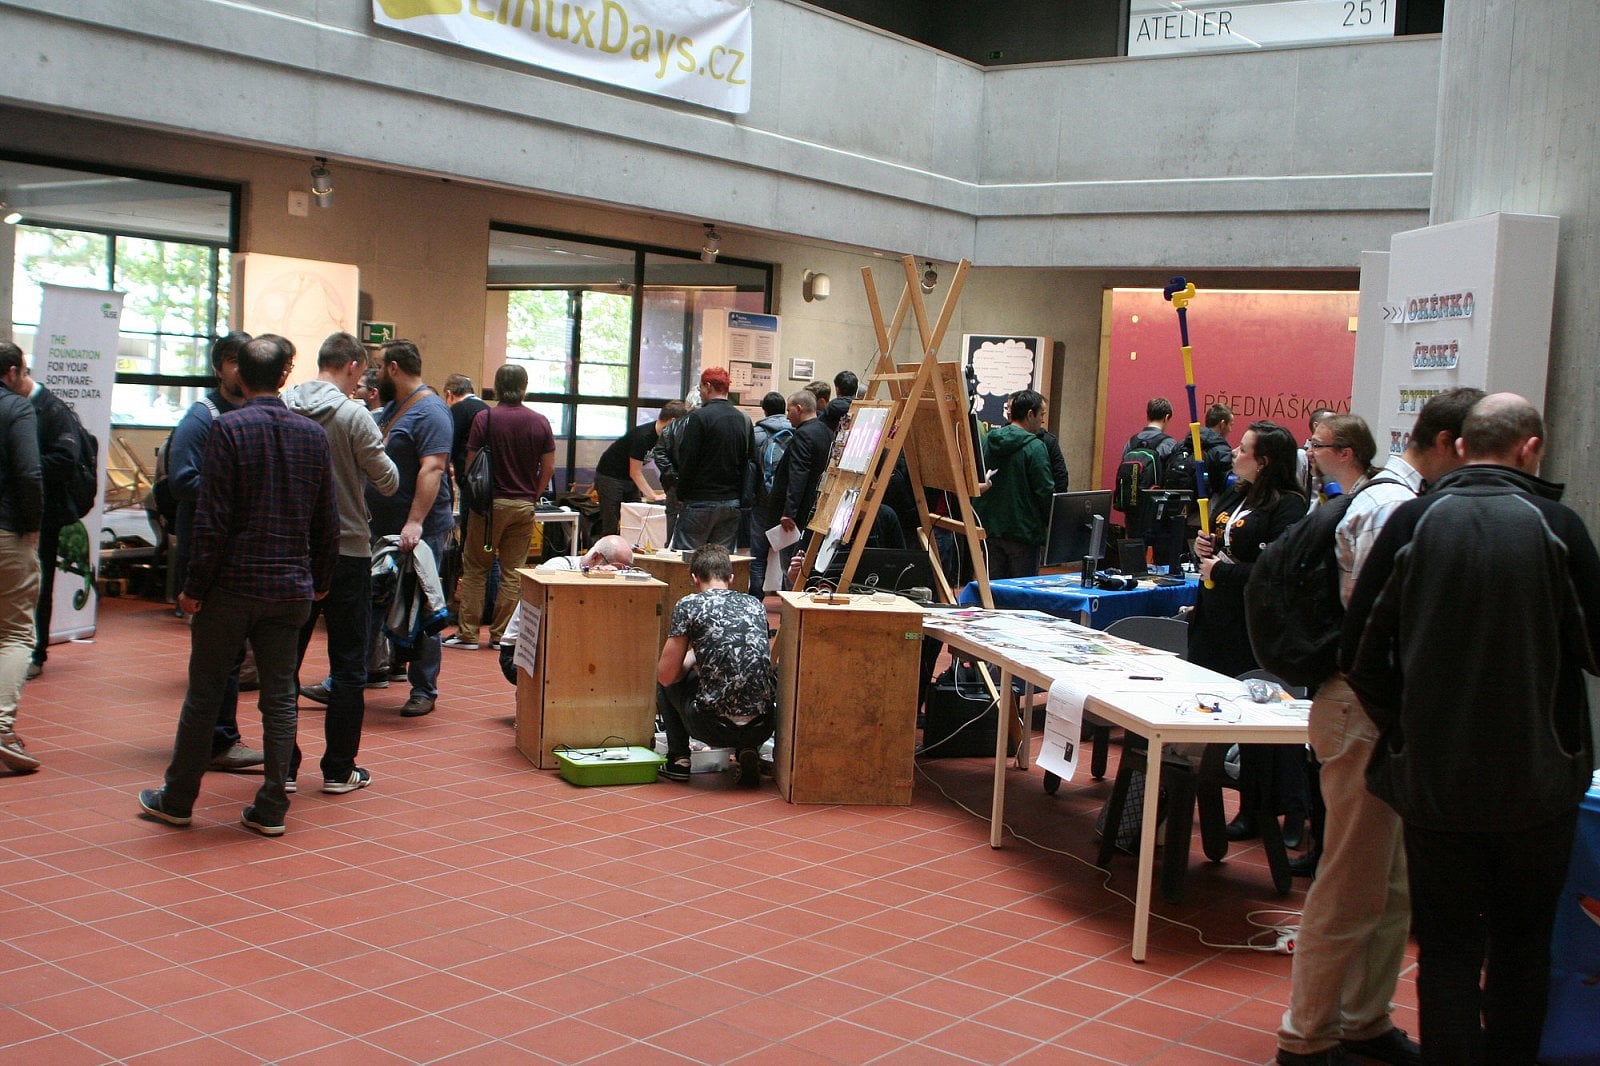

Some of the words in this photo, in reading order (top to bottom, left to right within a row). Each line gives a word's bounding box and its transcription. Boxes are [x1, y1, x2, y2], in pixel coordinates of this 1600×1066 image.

[1136, 10, 1232, 42] ATELIER
[1342, 0, 1388, 26] 251
[1408, 291, 1473, 321] OKÉNKO
[51, 335, 66, 345] THE
[48, 348, 100, 360] FOUNDATION
[47, 361, 64, 372] FOR
[66, 362, 88, 372] YOUR
[51, 388, 79, 398] EFINED
[81, 389, 102, 399] DATA
